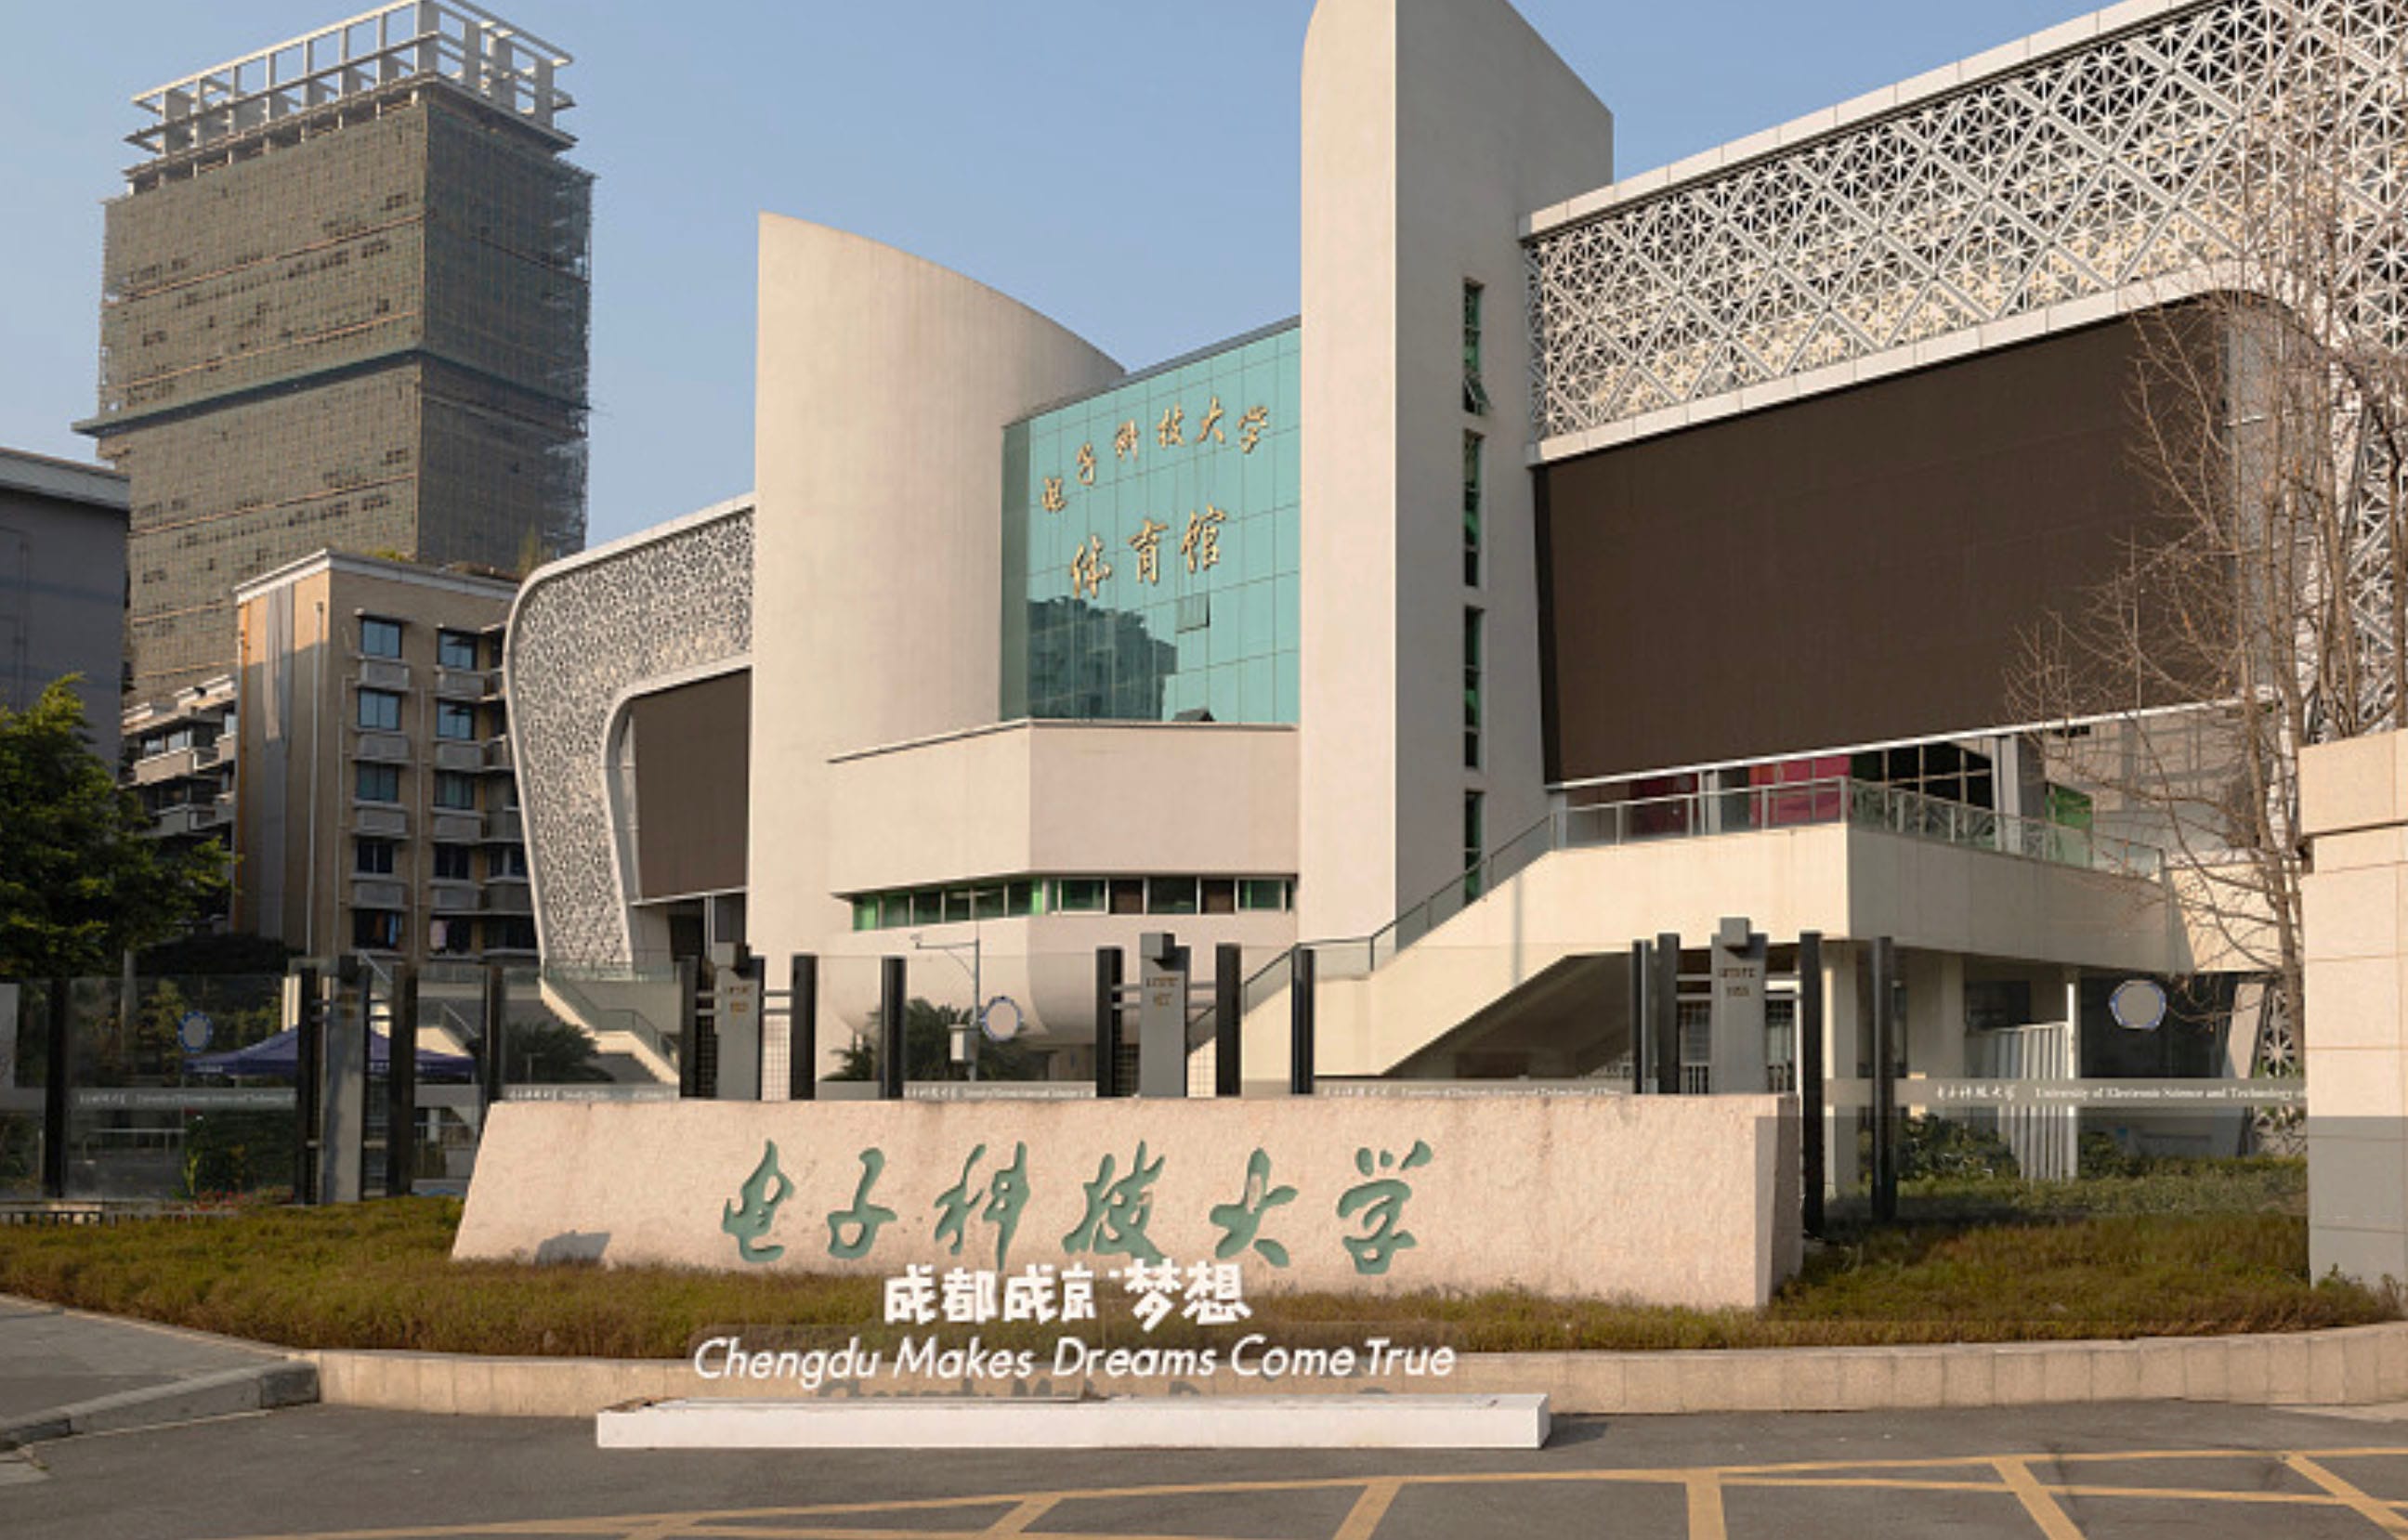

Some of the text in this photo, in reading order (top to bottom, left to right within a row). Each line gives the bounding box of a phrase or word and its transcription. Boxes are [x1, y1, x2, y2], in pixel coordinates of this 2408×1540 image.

[1041, 397, 1269, 513] 电子科技大学
[1071, 504, 1226, 598] 体育馆
[722, 1140, 1432, 1273] 电子科技大学
[693, 1333, 1457, 1390] Chengdu Makes Dreams Come True
